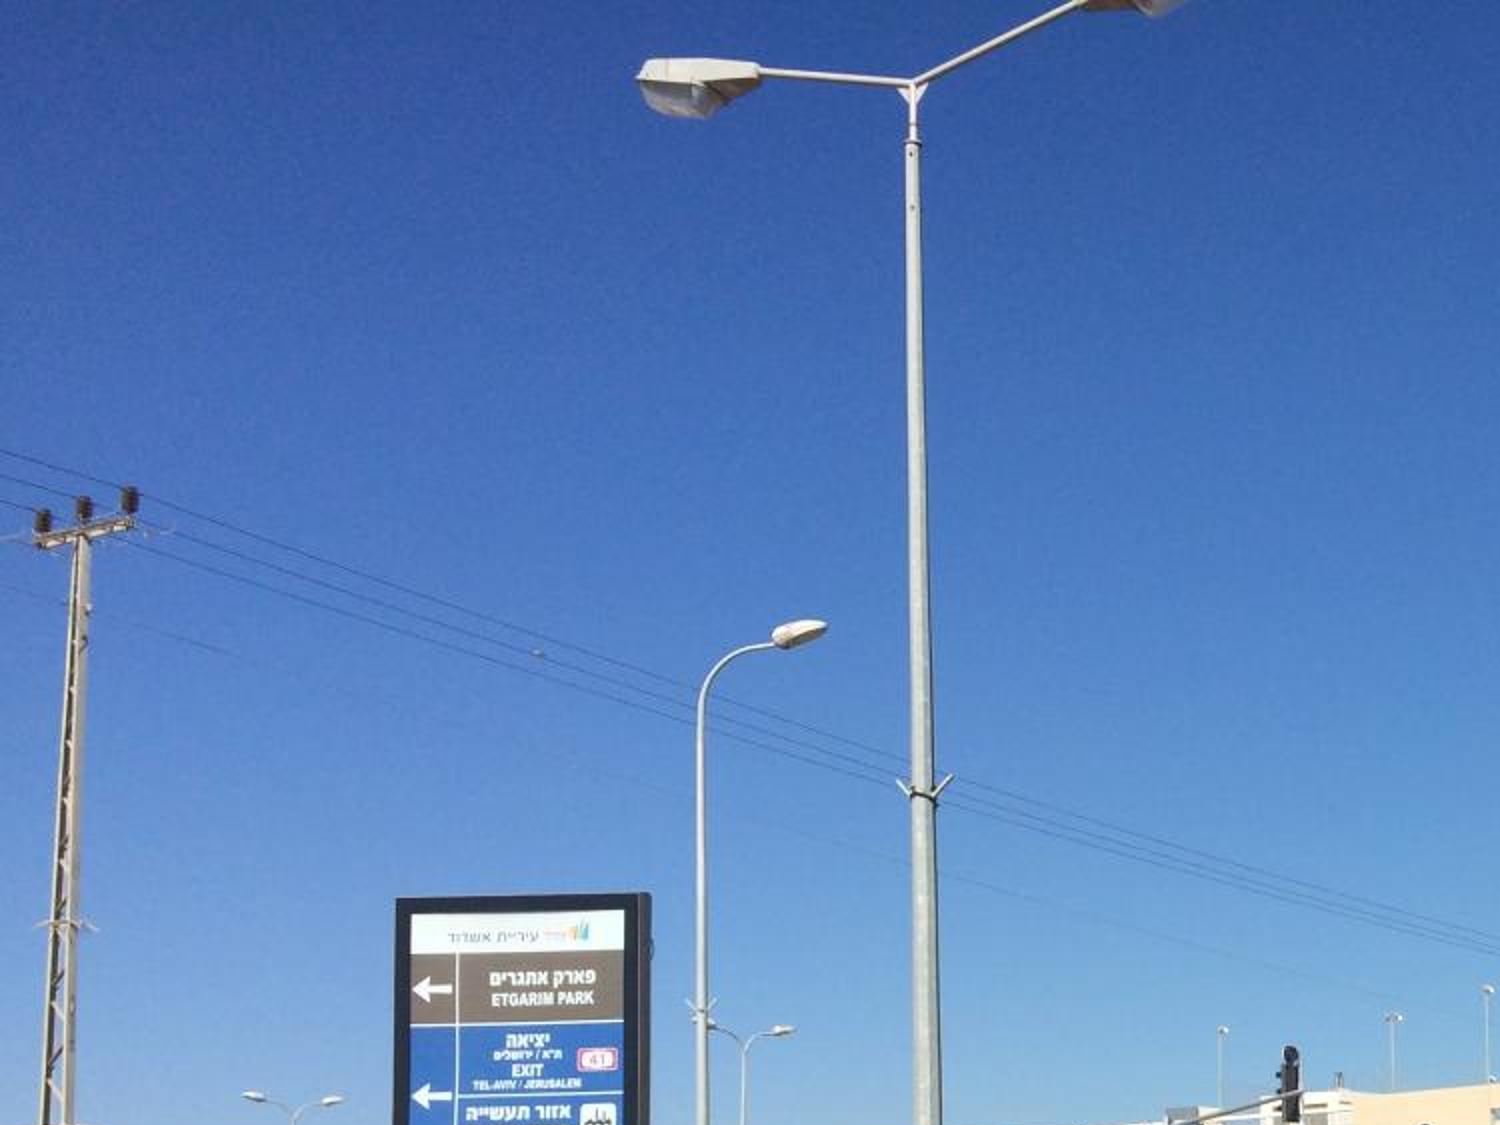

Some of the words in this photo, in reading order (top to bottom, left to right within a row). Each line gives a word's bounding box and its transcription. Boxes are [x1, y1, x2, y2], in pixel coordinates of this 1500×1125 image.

[496, 929, 539, 943] עיריית
[489, 970, 549, 987] אתגרים
[553, 969, 597, 988] פארק
[491, 992, 553, 1008] ETGARIM
[557, 990, 595, 1006] PARK
[505, 1033, 551, 1049] יציאה
[588, 1053, 607, 1065] 41
[511, 1063, 545, 1077] EXIT
[523, 1077, 583, 1090] JERUSALEM
[466, 1105, 531, 1121] תעשייה
[534, 1104, 572, 1120] אזור
